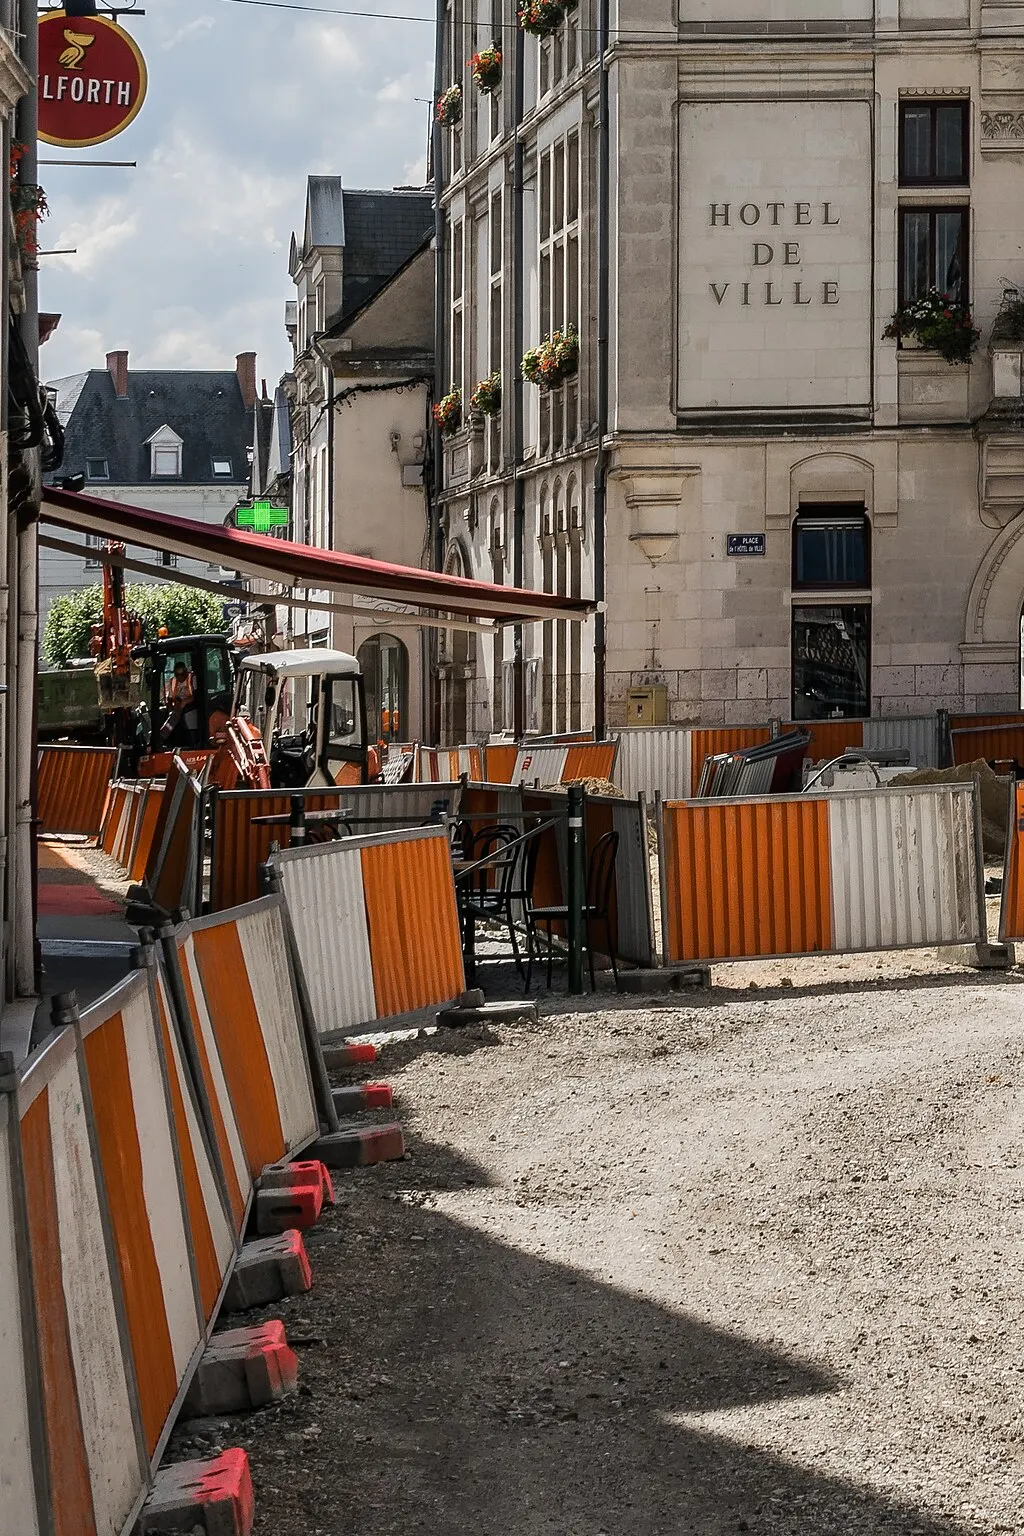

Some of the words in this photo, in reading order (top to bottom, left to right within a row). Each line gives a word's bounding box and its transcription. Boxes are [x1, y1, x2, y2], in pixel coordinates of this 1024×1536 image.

[38, 74, 131, 106] LFORTH
[709, 202, 840, 227] HOTEL
[752, 242, 801, 266] DE
[709, 281, 840, 306] VILLE
